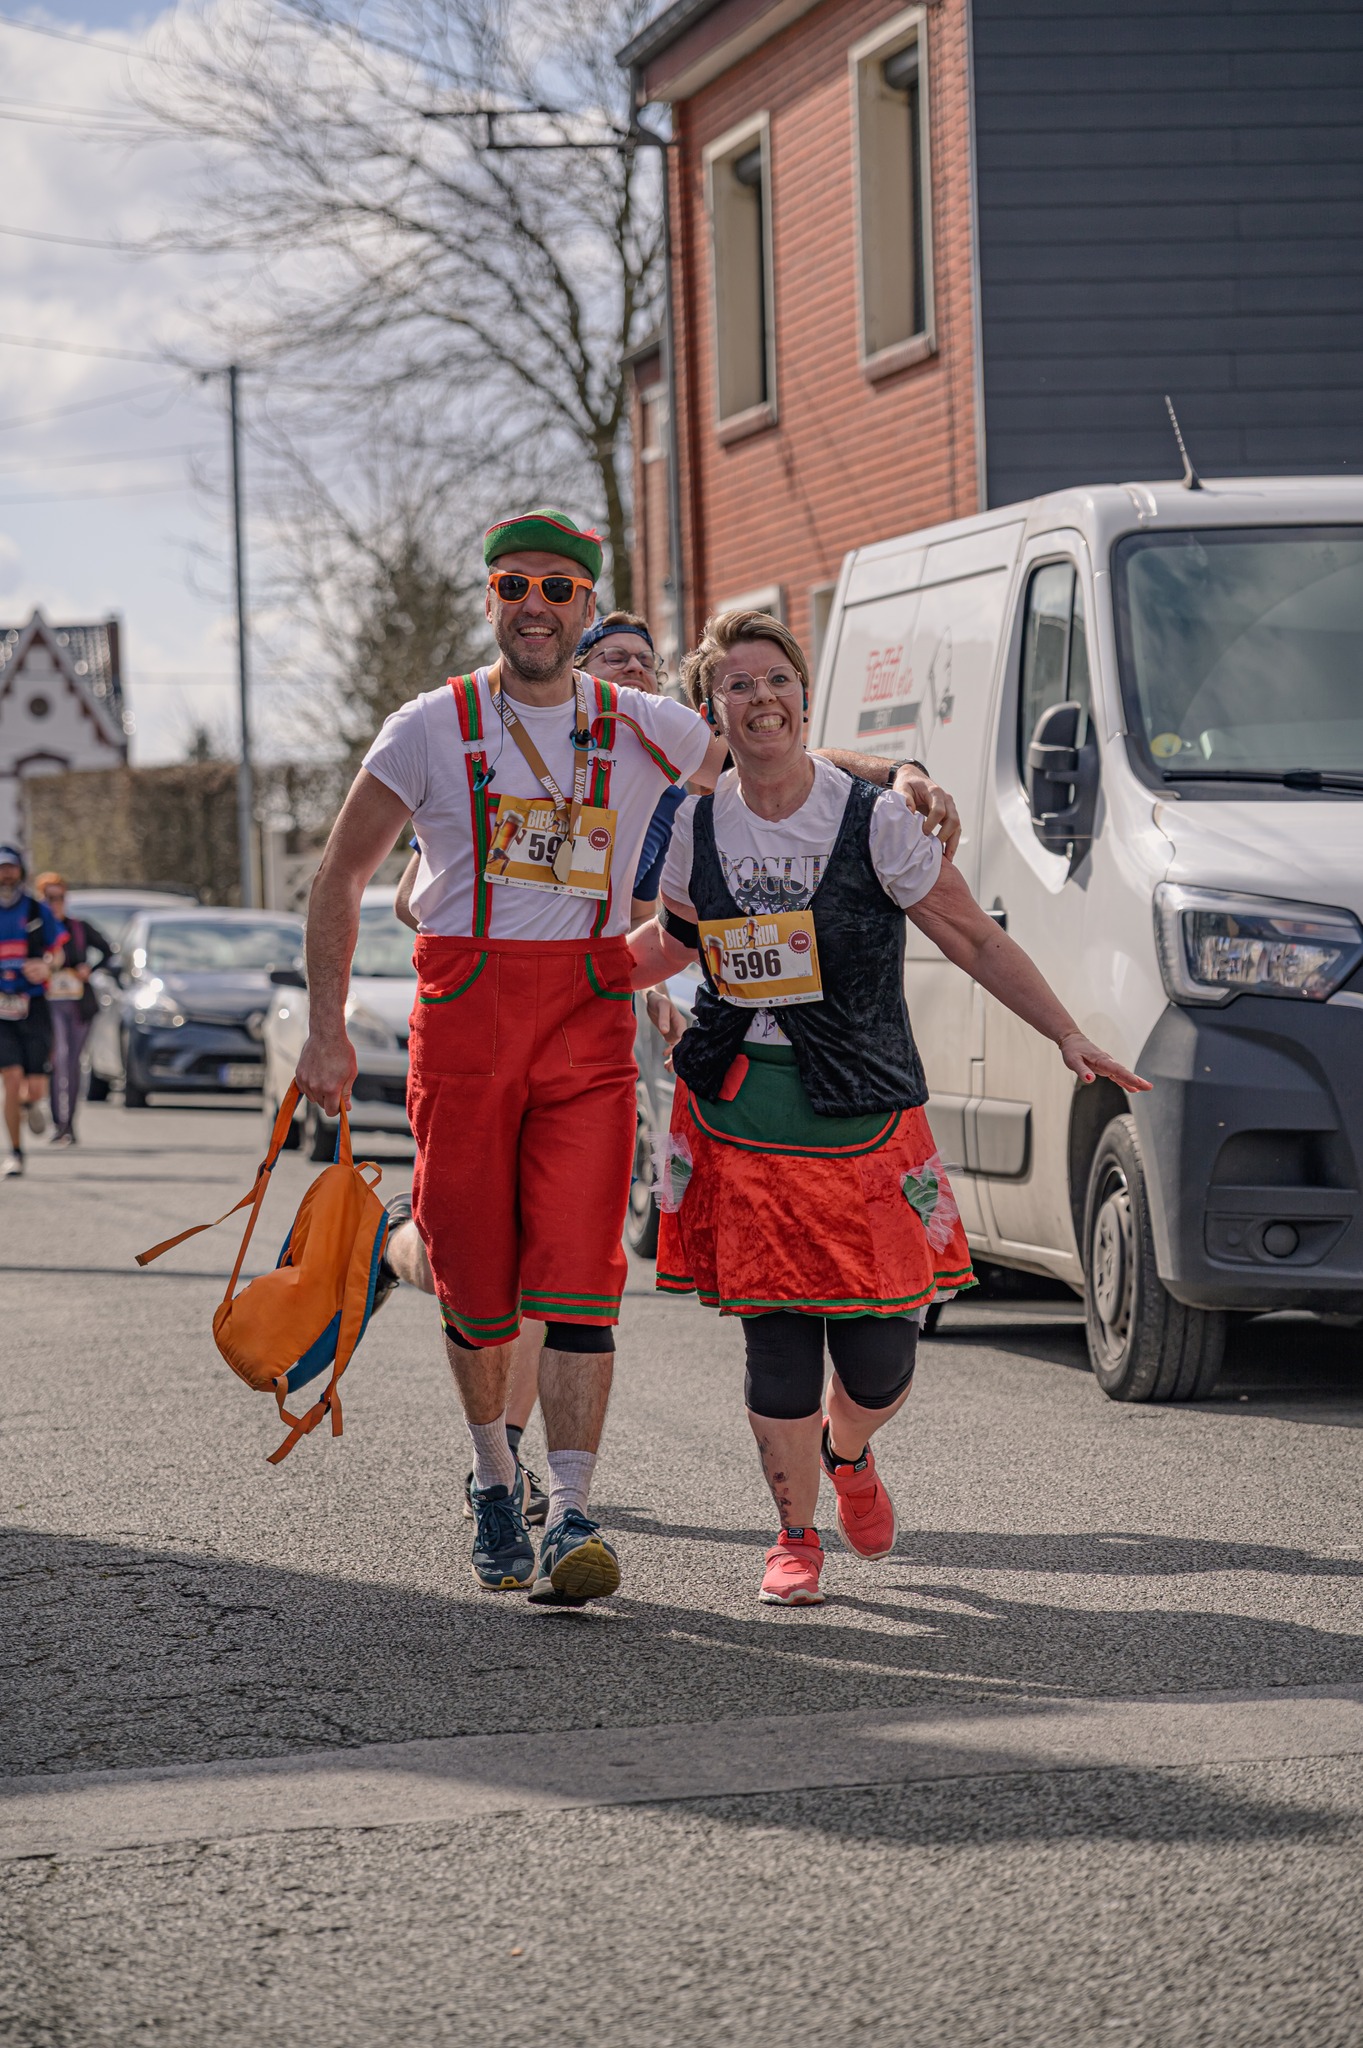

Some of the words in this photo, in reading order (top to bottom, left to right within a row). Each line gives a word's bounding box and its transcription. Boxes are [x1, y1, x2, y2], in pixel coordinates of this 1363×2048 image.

[575, 766, 586, 785] RUN
[540, 775, 559, 794] BIER
[554, 793, 567, 811] RUN
[573, 784, 584, 805] BIER
[754, 923, 779, 946] RUN
[732, 948, 782, 981] 596
